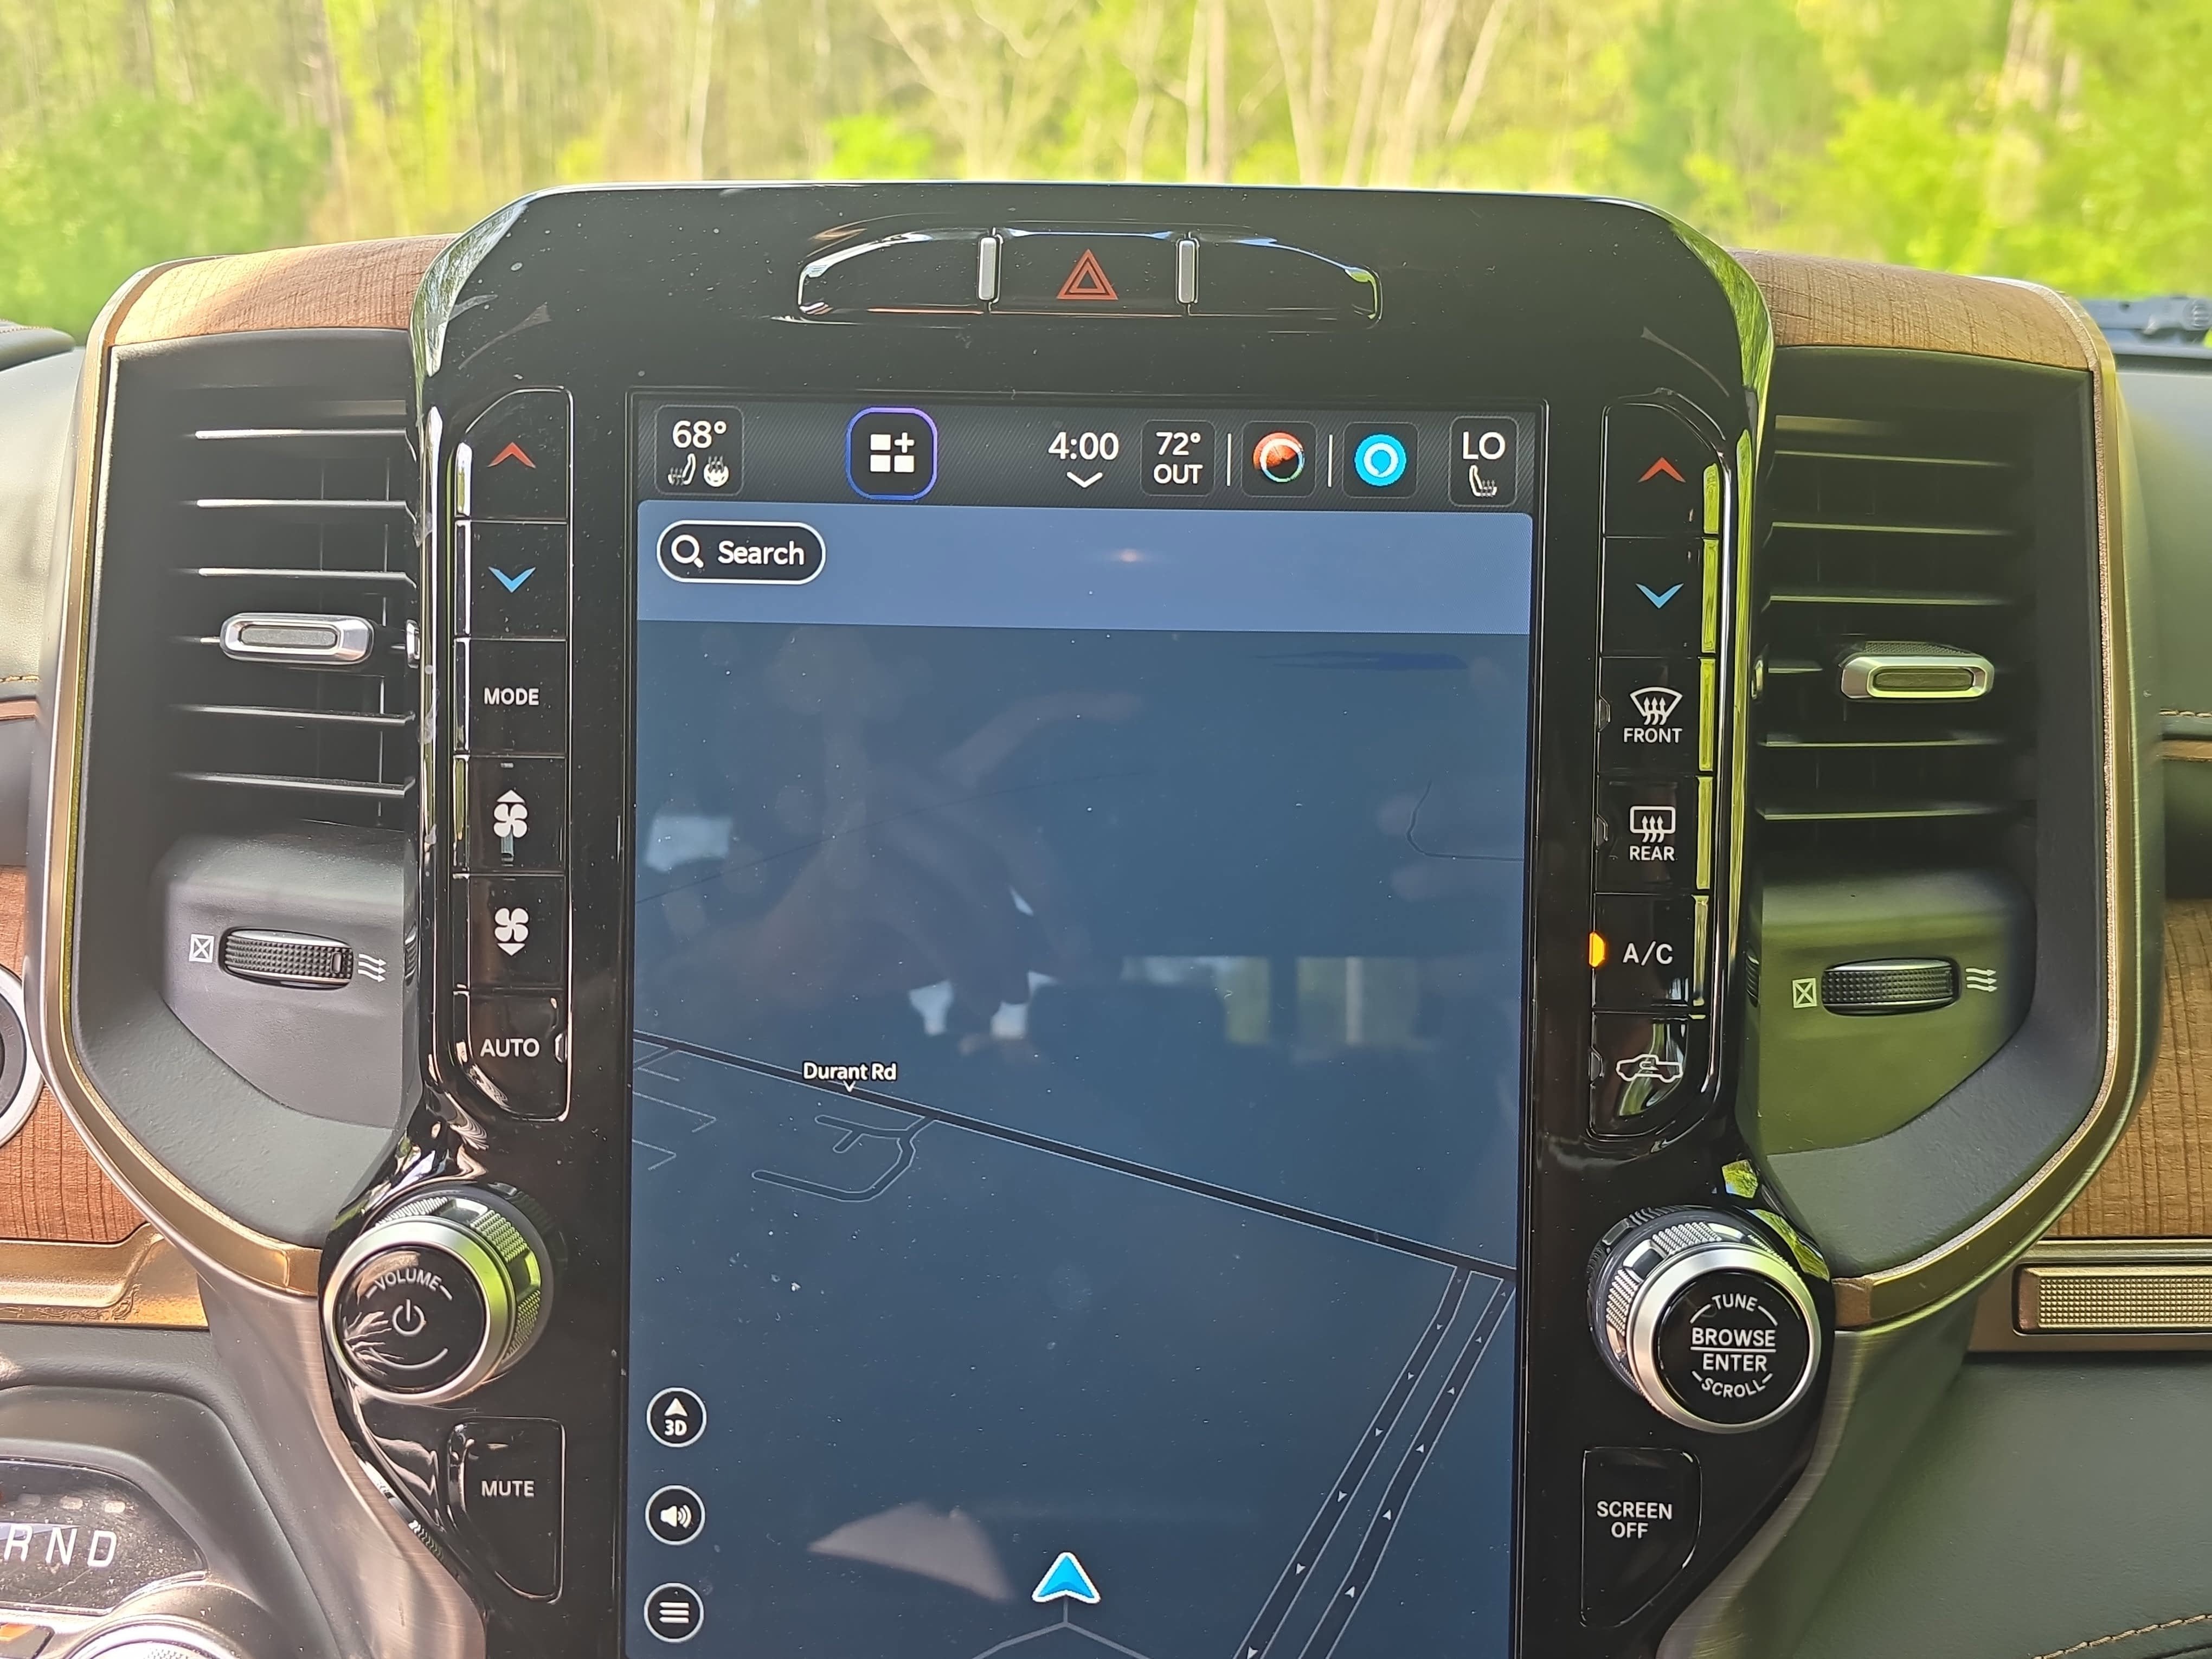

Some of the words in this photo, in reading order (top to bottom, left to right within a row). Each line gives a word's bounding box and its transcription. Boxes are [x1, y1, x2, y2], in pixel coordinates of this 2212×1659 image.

[671, 420, 728, 449] 68°
[1155, 431, 1202, 456] 72°
[1047, 431, 1120, 461] 4:00
[1462, 431, 1506, 460] LO
[1153, 462, 1204, 485] OUT
[717, 540, 805, 567] Search
[483, 687, 540, 706] MODE
[1623, 727, 1683, 744] FRONT
[1629, 845, 1675, 862] REAR
[1622, 940, 1674, 965] A/C
[479, 1038, 541, 1058] AUTO
[803, 1062, 868, 1081] Durant
[871, 1063, 897, 1081] Rd
[375, 1268, 442, 1291] VOLUME
[1712, 1293, 1758, 1313] TUNE
[1690, 1327, 1777, 1348] BROWSE
[1702, 1353, 1767, 1372] ENTER
[1701, 1377, 1766, 1399] SCROLL
[664, 1419, 687, 1436] 3D
[481, 1480, 535, 1497] MUTE
[1596, 1500, 1673, 1520] SCREEN
[1610, 1521, 1649, 1539] OFF
